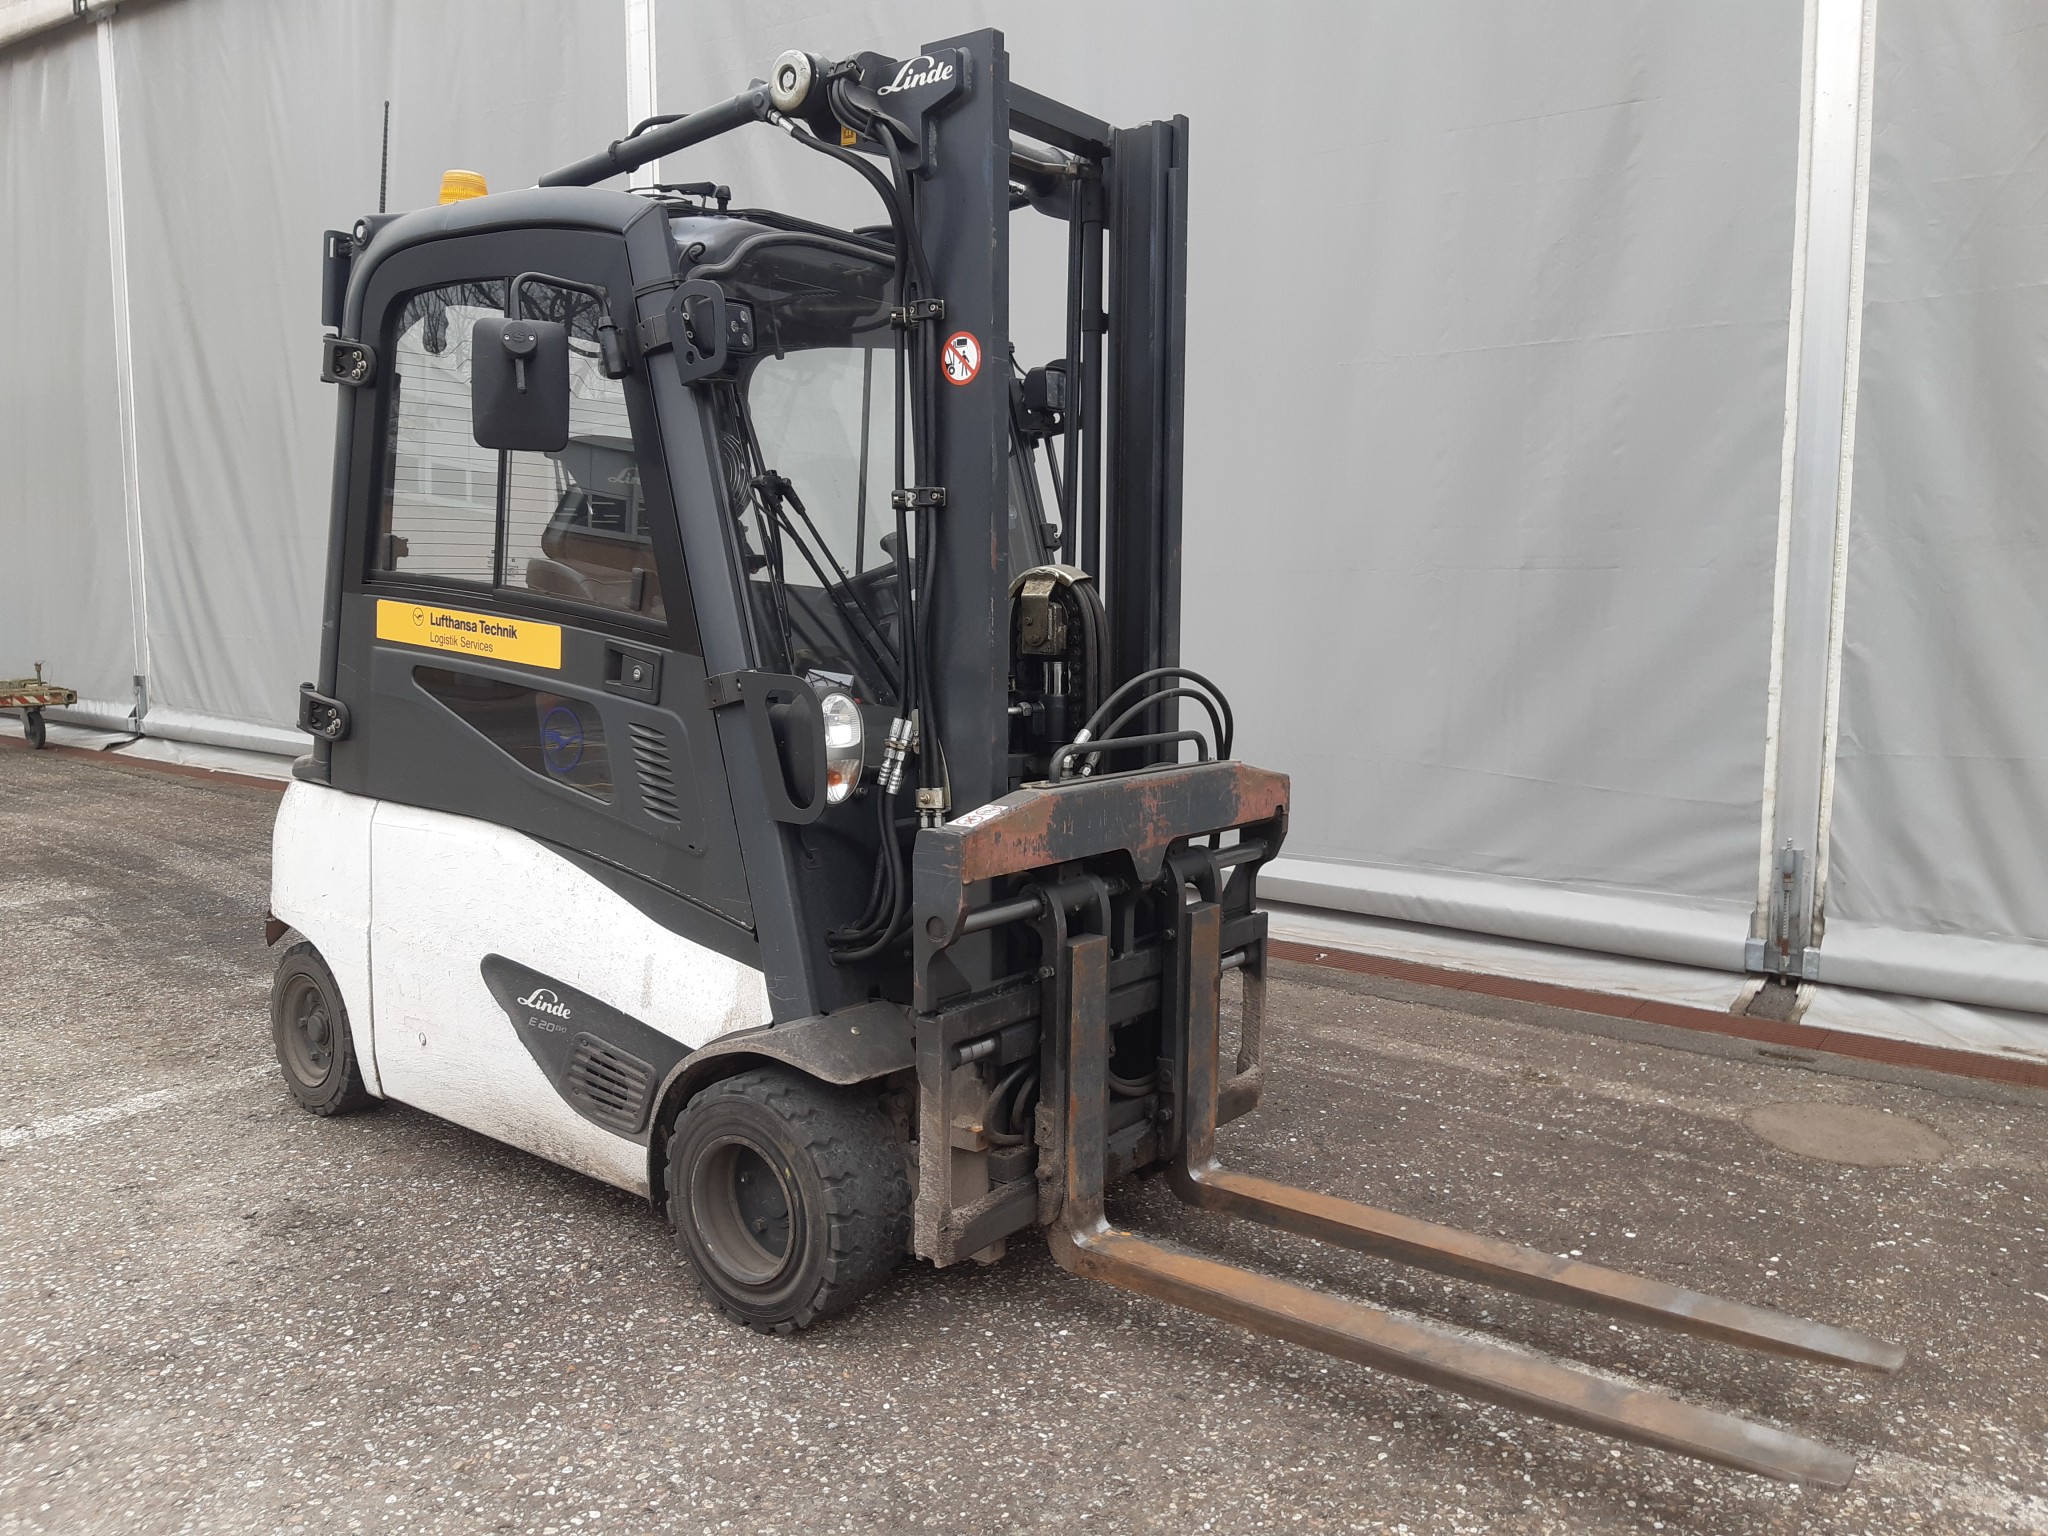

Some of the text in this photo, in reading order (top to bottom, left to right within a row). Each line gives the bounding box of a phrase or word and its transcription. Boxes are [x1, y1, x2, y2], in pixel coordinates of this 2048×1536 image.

[877, 55, 953, 95] Linde
[430, 612, 518, 639] Lufthansa Technik
[430, 631, 494, 653] Logistik Services
[517, 988, 571, 1019] Linde
